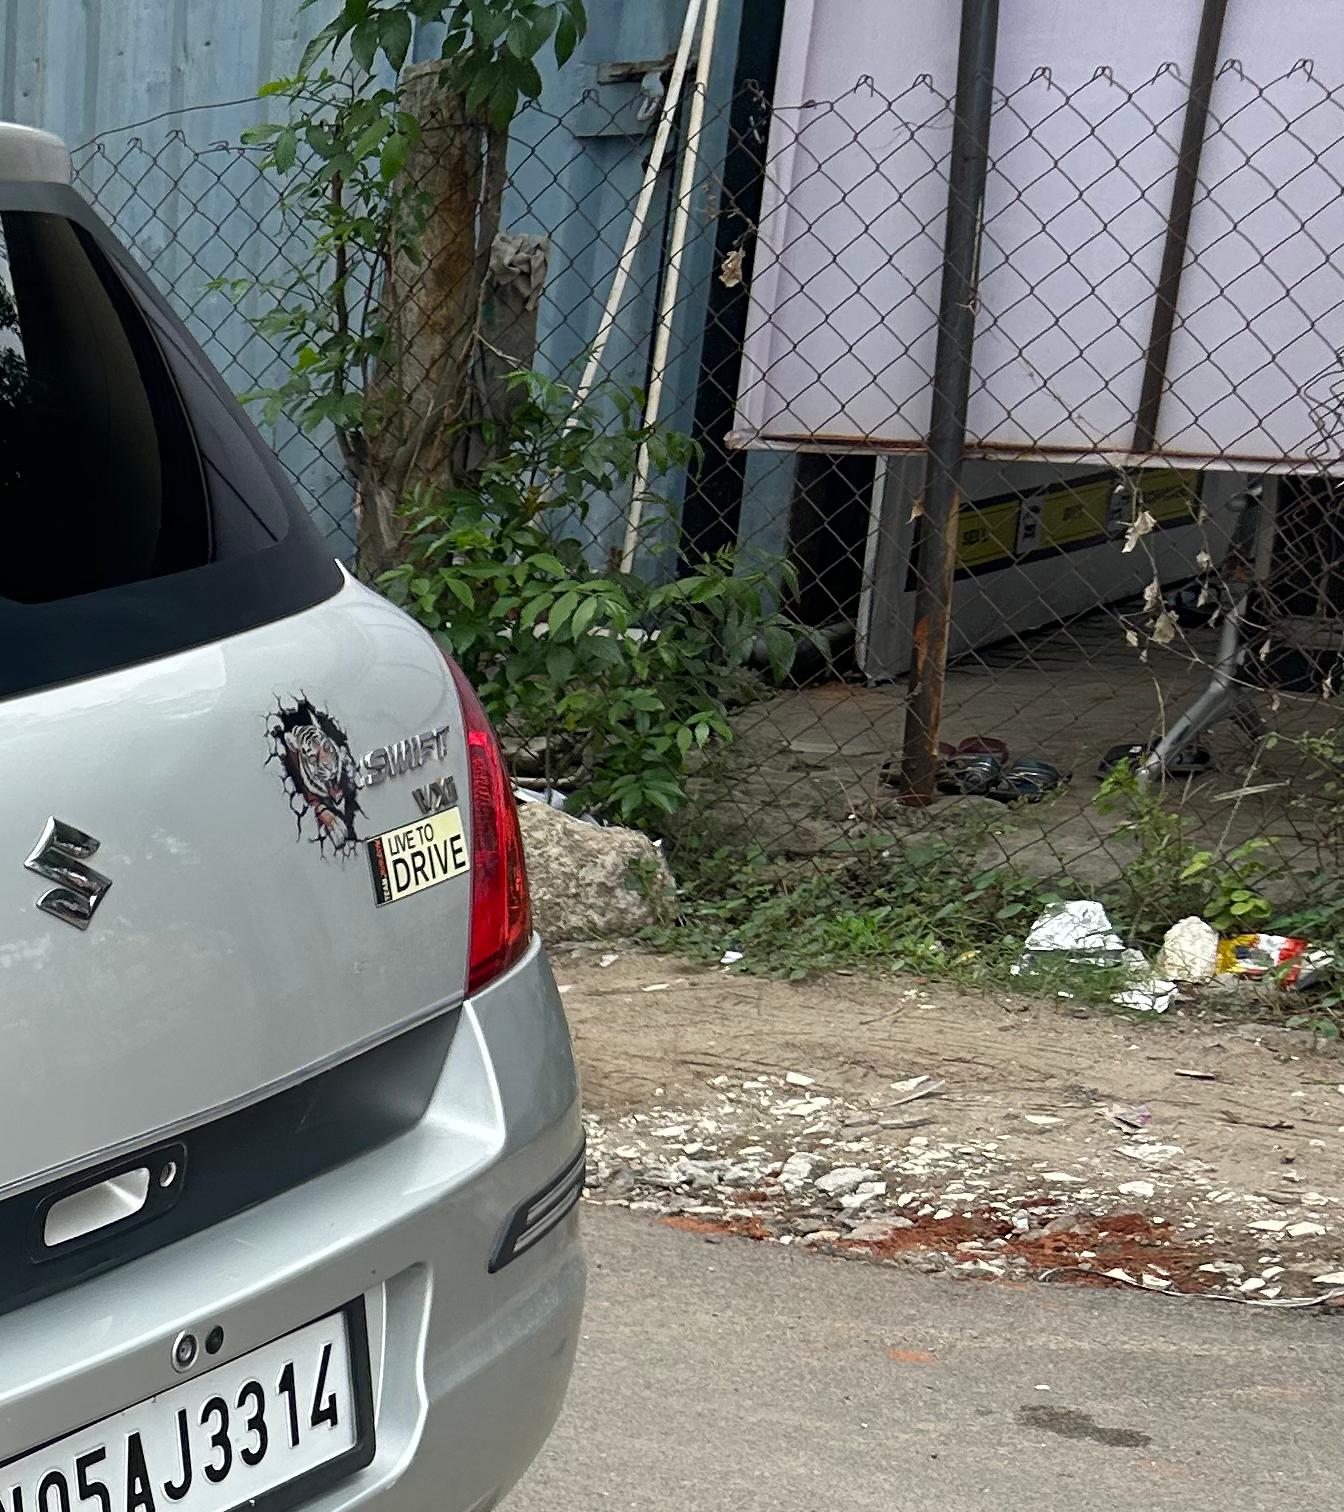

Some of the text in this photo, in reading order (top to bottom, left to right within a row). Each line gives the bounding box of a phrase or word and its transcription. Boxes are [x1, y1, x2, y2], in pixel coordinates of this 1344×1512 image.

[363, 725, 450, 787] SWIFT
[387, 822, 434, 857] LIVE TO
[391, 833, 467, 893] DRIVE
